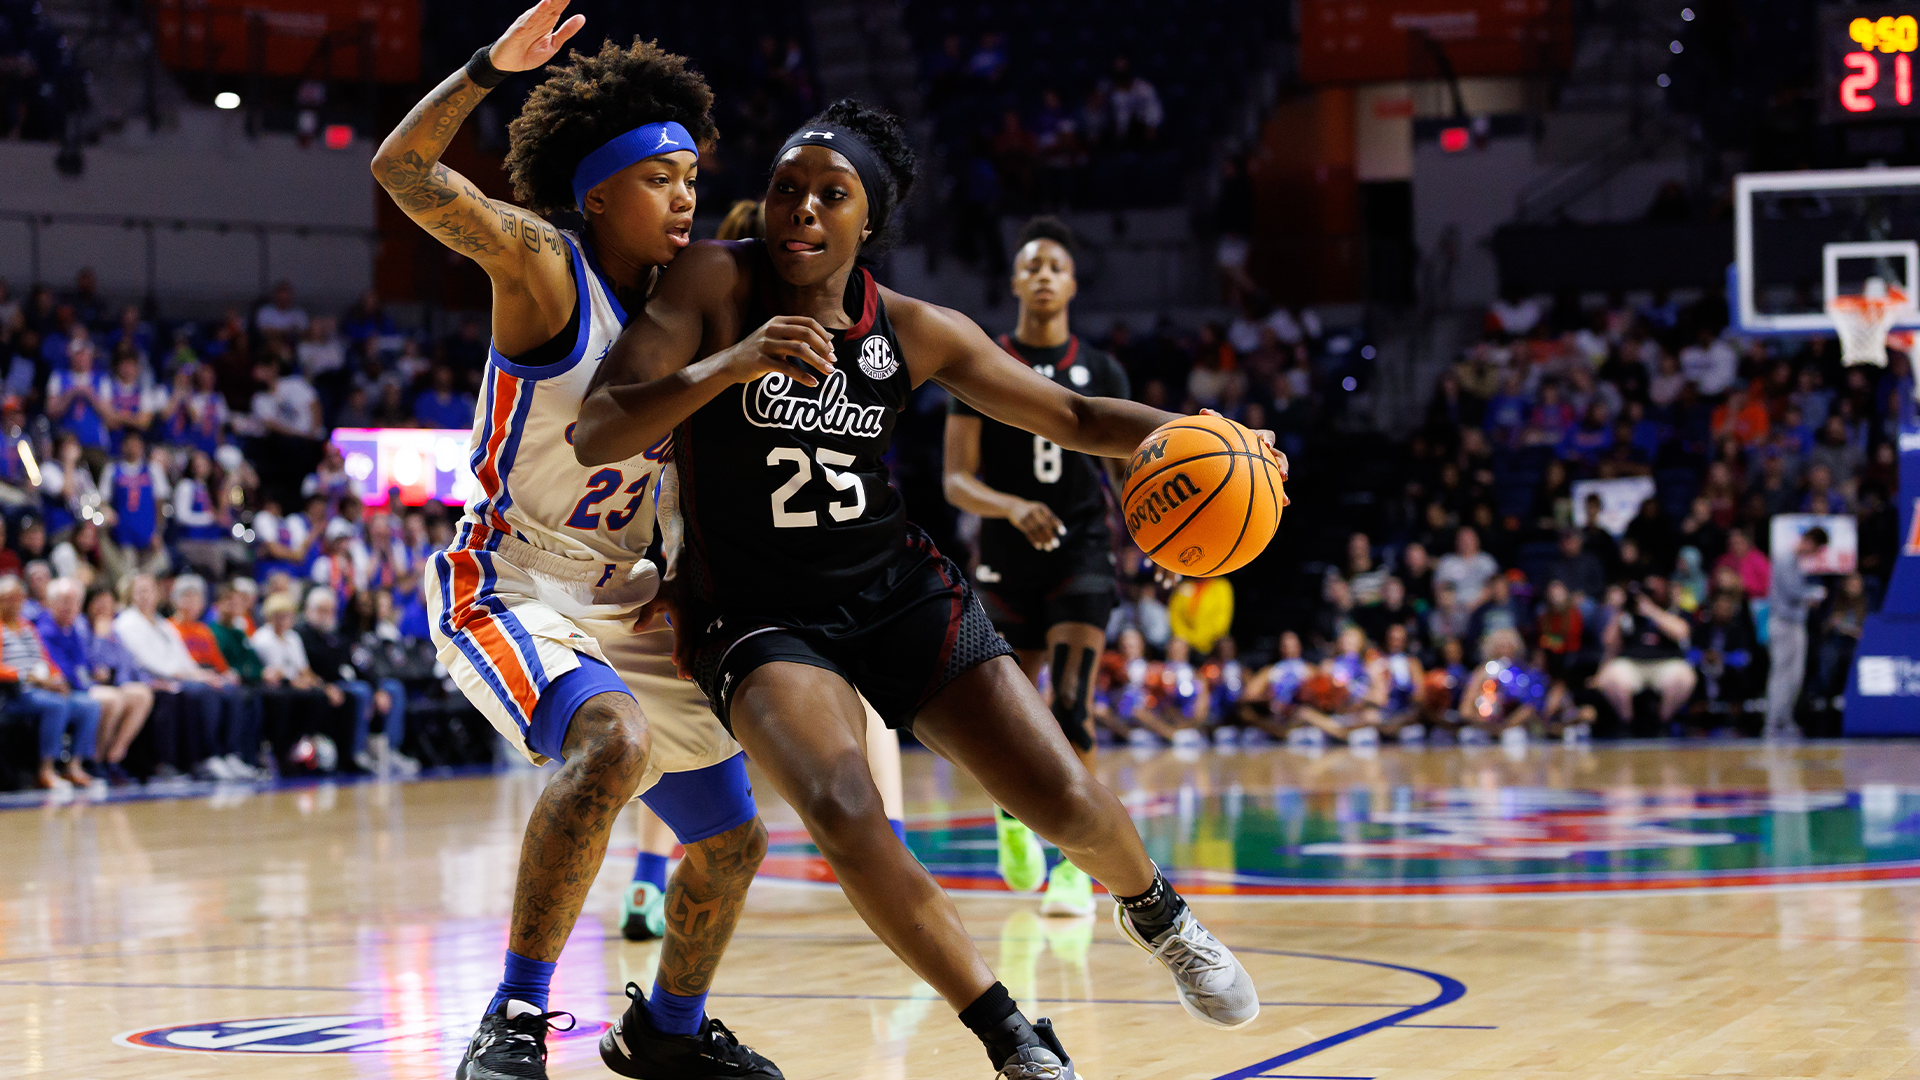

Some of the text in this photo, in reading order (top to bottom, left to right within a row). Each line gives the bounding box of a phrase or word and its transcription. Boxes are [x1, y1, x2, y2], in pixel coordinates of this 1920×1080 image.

[1840, 51, 1912, 112] 21
[864, 337, 891, 369] SEC
[743, 369, 885, 438] Carolina
[766, 447, 866, 528] 25
[1033, 434, 1063, 484] 8
[564, 467, 652, 531] 23
[1127, 472, 1202, 539] Wilson
[595, 563, 616, 588] F
